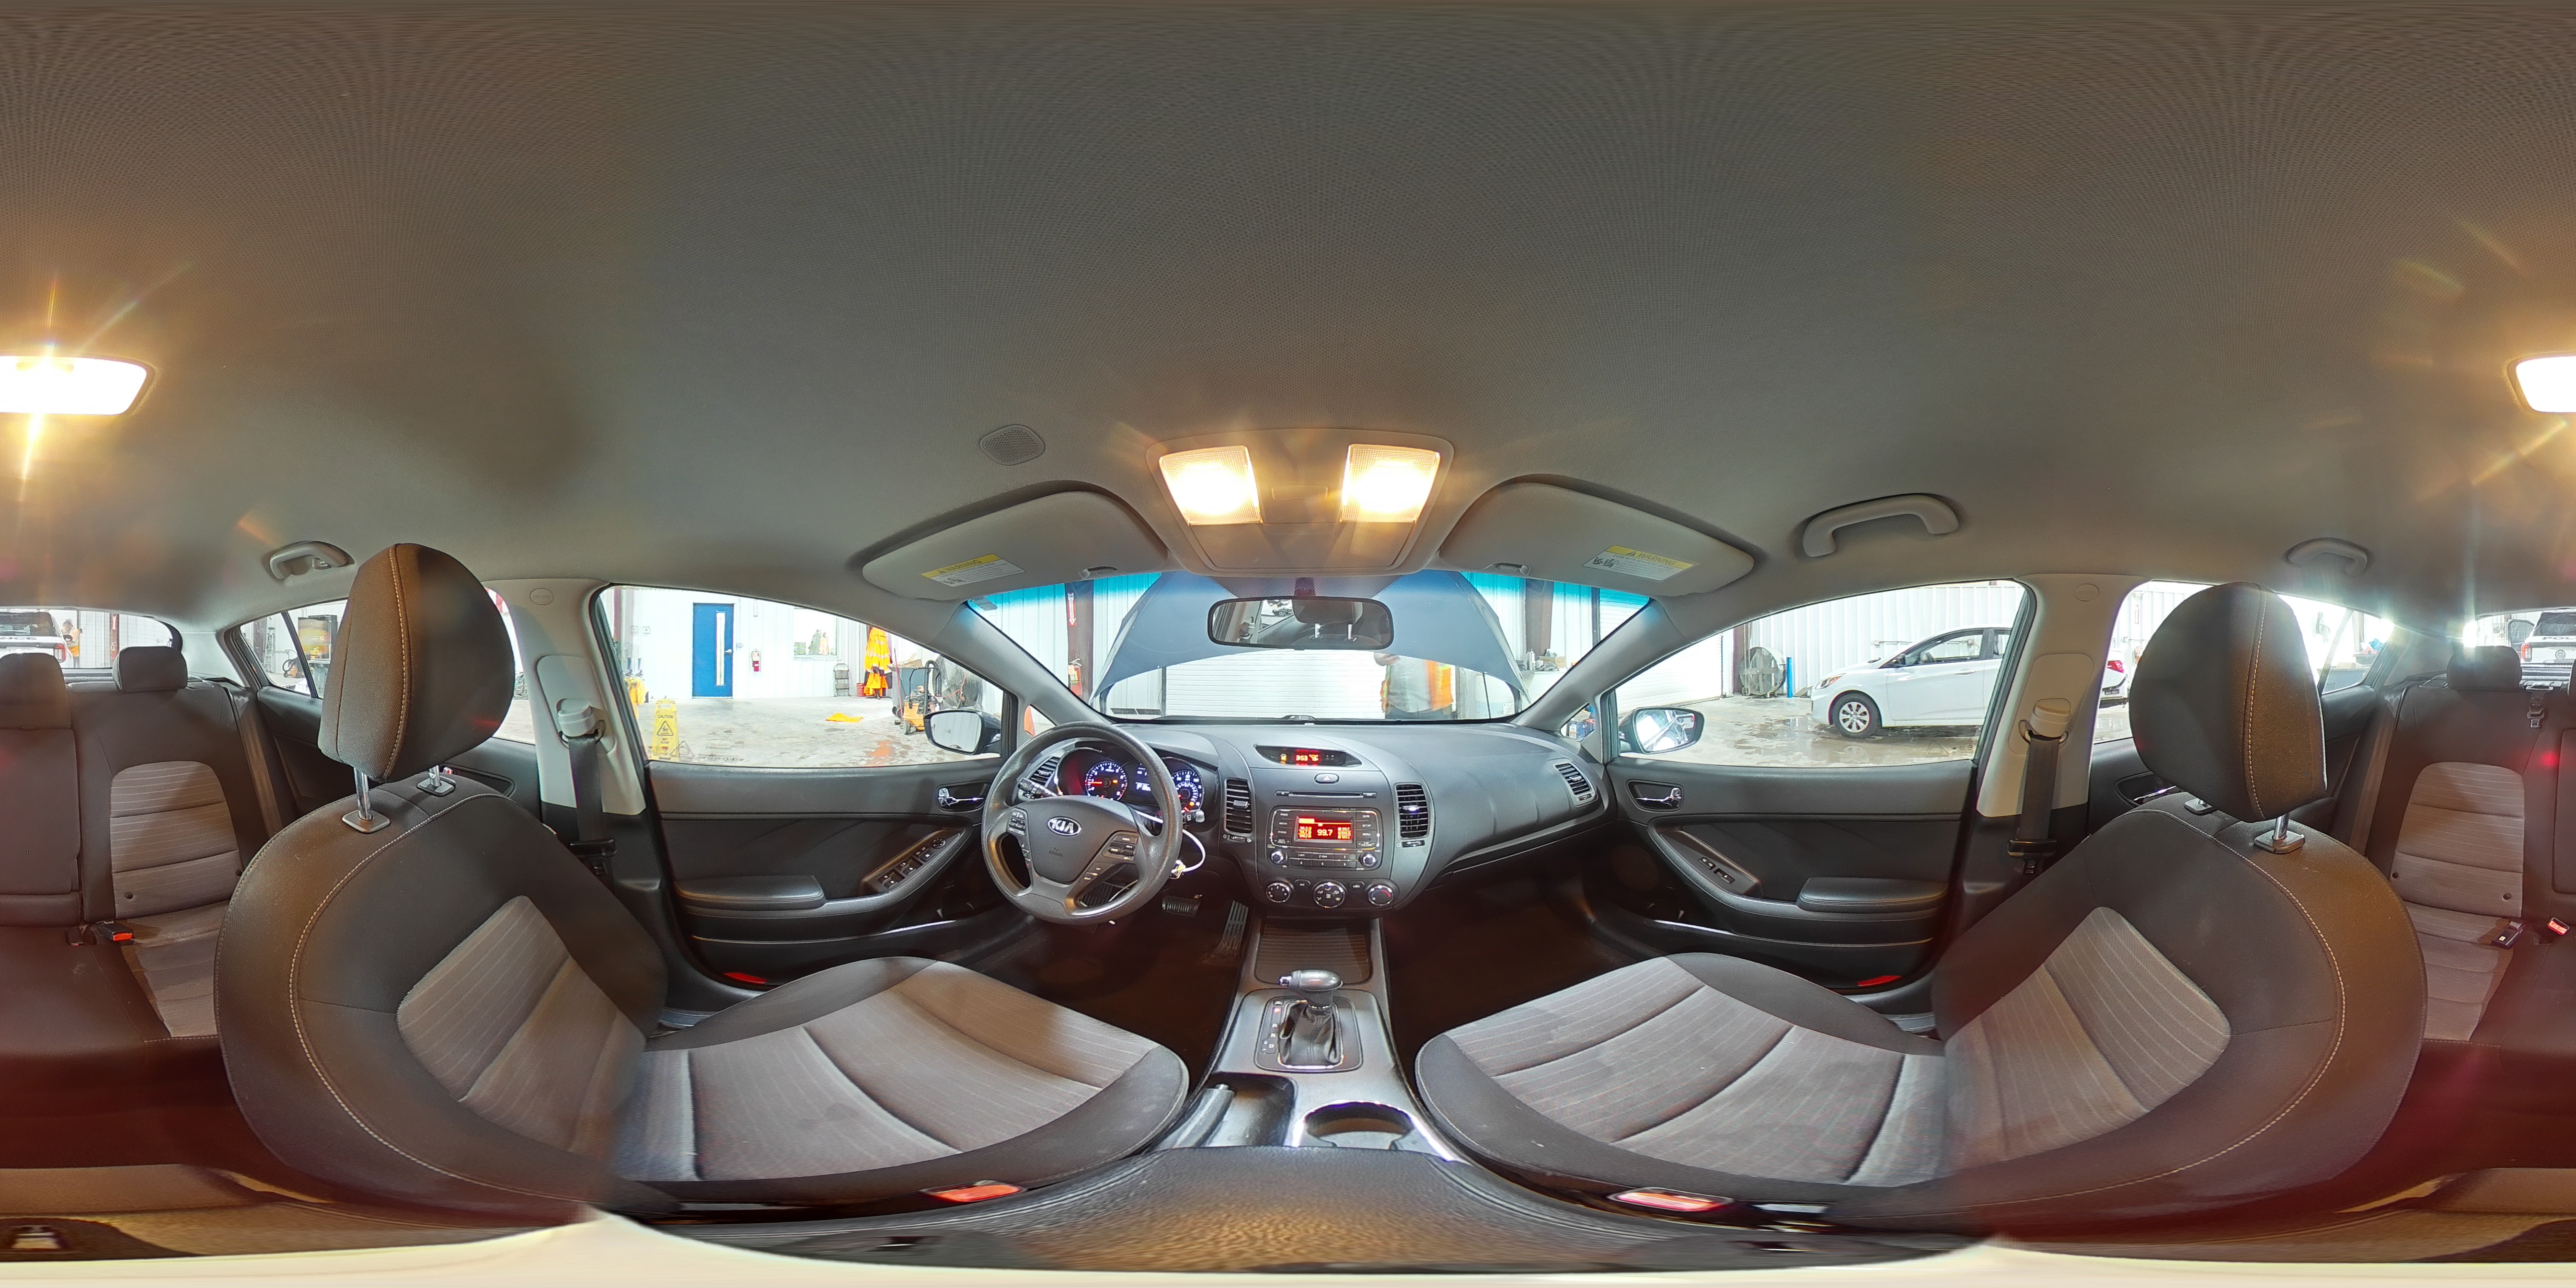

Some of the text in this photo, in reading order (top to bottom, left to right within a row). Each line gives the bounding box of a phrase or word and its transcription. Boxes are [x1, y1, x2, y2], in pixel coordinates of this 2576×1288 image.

[1638, 552, 1677, 565] WARNING
[943, 559, 982, 572] WARNING
[1051, 819, 1074, 834] KIA
